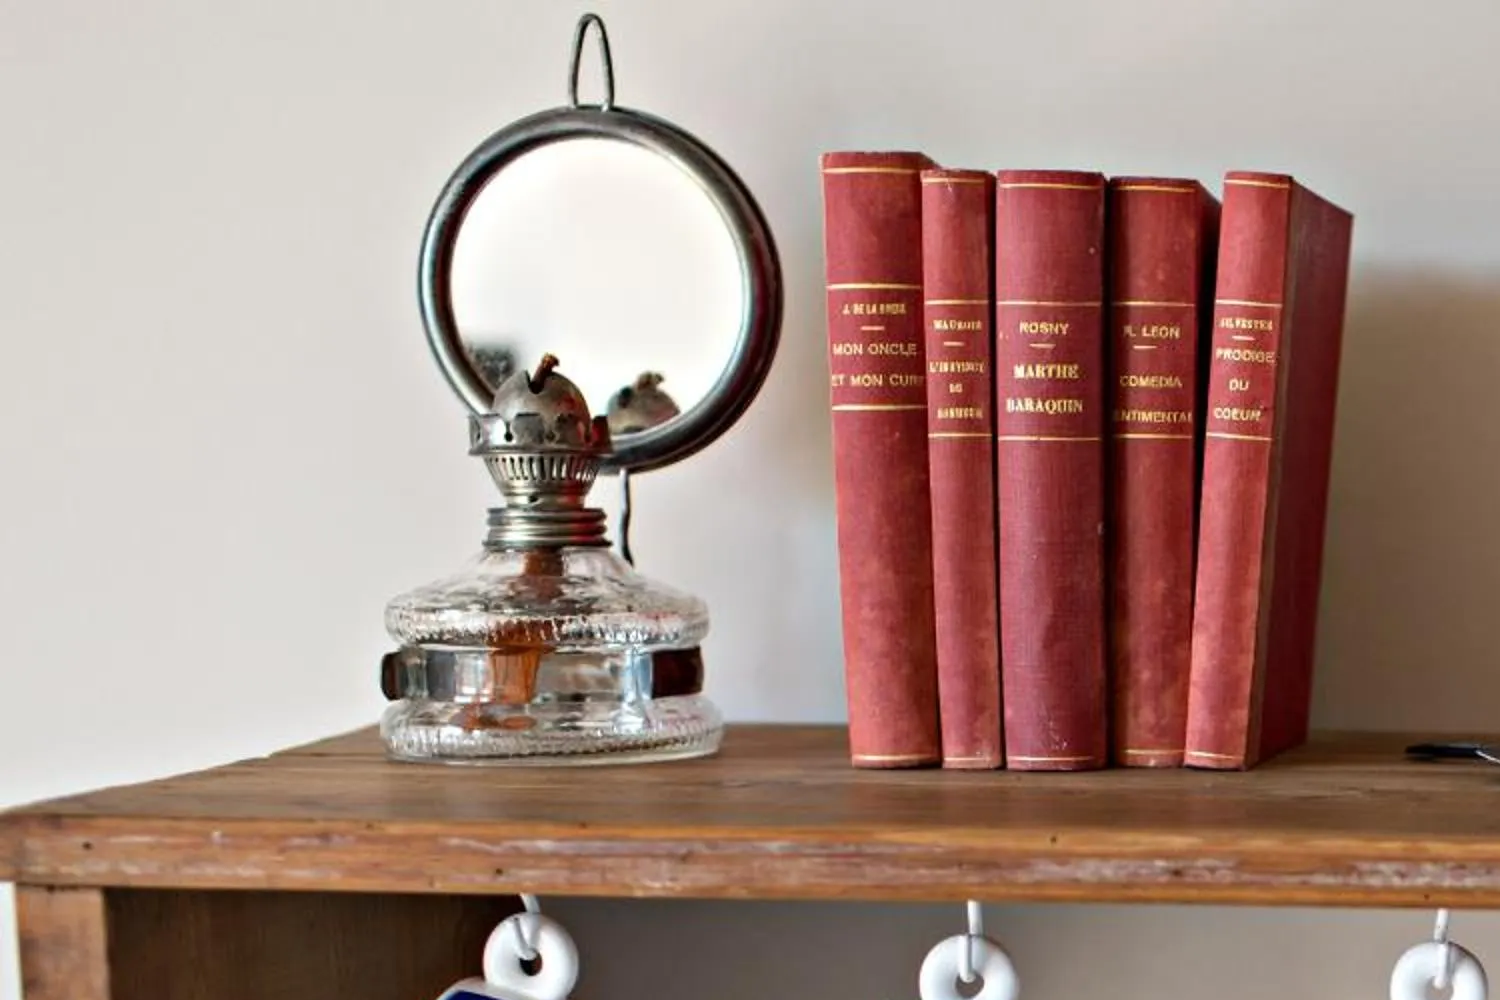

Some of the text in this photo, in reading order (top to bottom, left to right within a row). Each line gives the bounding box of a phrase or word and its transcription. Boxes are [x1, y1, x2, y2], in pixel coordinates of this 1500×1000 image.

[1019, 321, 1069, 335] ROSNY
[833, 343, 917, 357] MON ONCLE
[1013, 364, 1080, 379] MARTHE
[831, 374, 844, 387] ET
[850, 373, 883, 387] MON
[1120, 375, 1183, 389] COMEDIA
[1006, 398, 1084, 415] BARAQUIN
